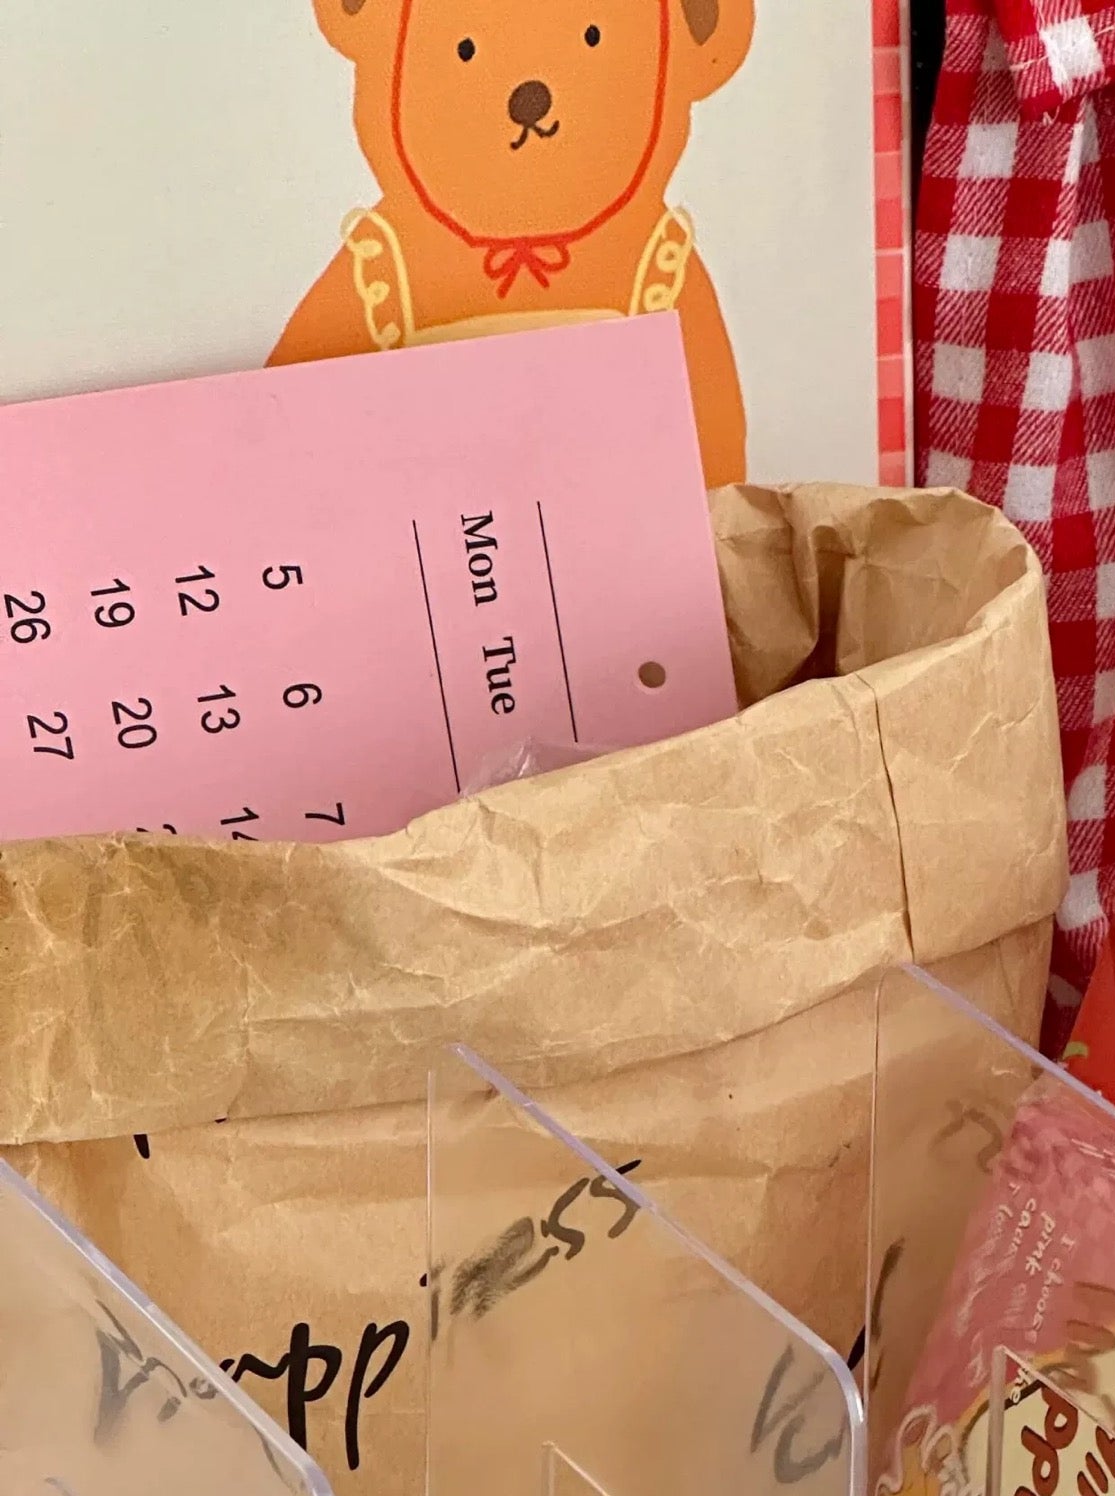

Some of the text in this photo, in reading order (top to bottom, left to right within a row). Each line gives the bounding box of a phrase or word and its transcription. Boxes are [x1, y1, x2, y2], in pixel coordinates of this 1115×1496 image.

[4, 590, 74, 760] 26 27
[90, 578, 157, 749] 19 20
[175, 565, 220, 616] 12
[461, 510, 517, 715] Mon Tue
[197, 684, 241, 734] 13
[262, 565, 345, 825] 5 6 7
[1010, 1364, 1033, 1404] he
